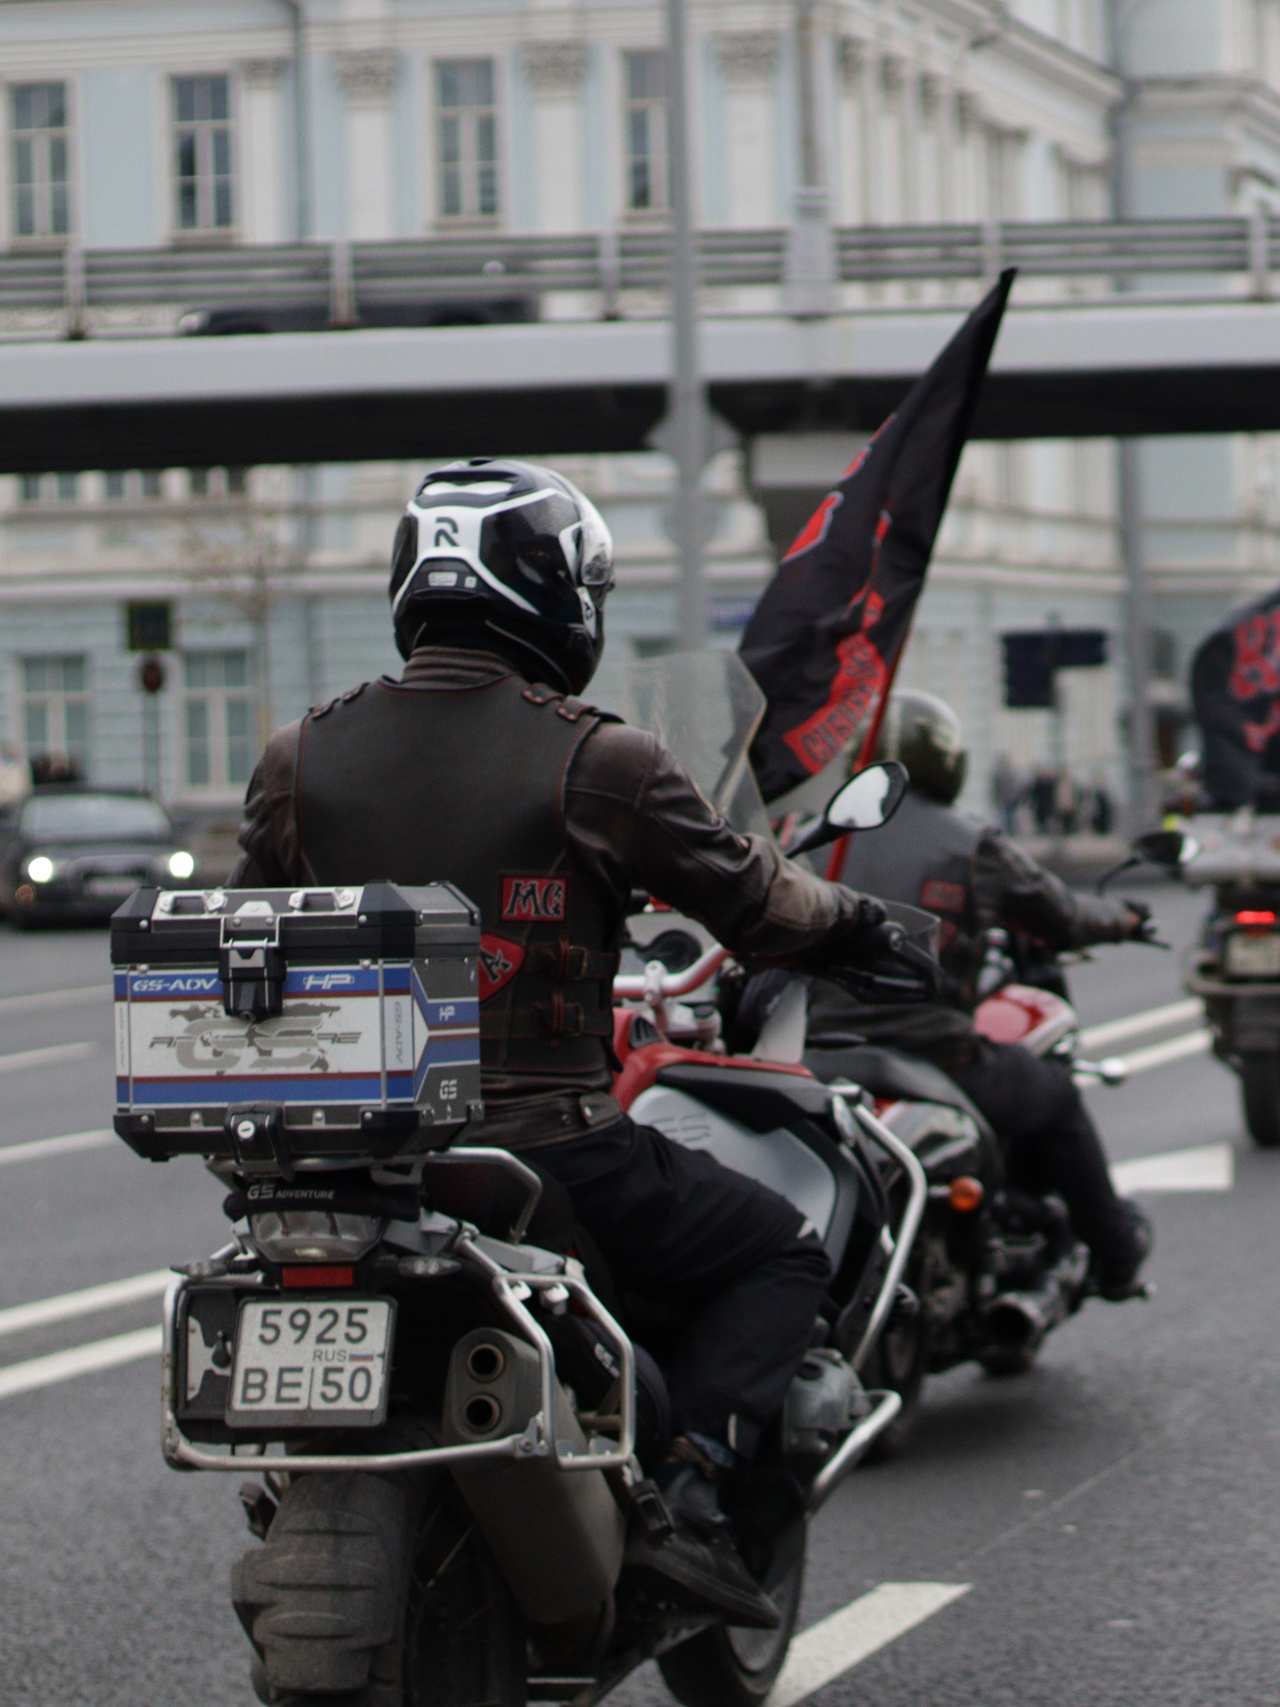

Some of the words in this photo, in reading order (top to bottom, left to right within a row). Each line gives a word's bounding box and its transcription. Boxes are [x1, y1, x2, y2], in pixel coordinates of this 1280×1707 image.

[505, 880, 564, 917] MG
[132, 978, 217, 993] GS-ADV
[304, 973, 354, 991] HP
[439, 1079, 457, 1100] GS
[247, 1184, 275, 1200] GS
[275, 1188, 335, 1200] ADVENTURE
[258, 1308, 369, 1345] 5925
[312, 1350, 346, 1362] RUS
[320, 1366, 372, 1403] 50
